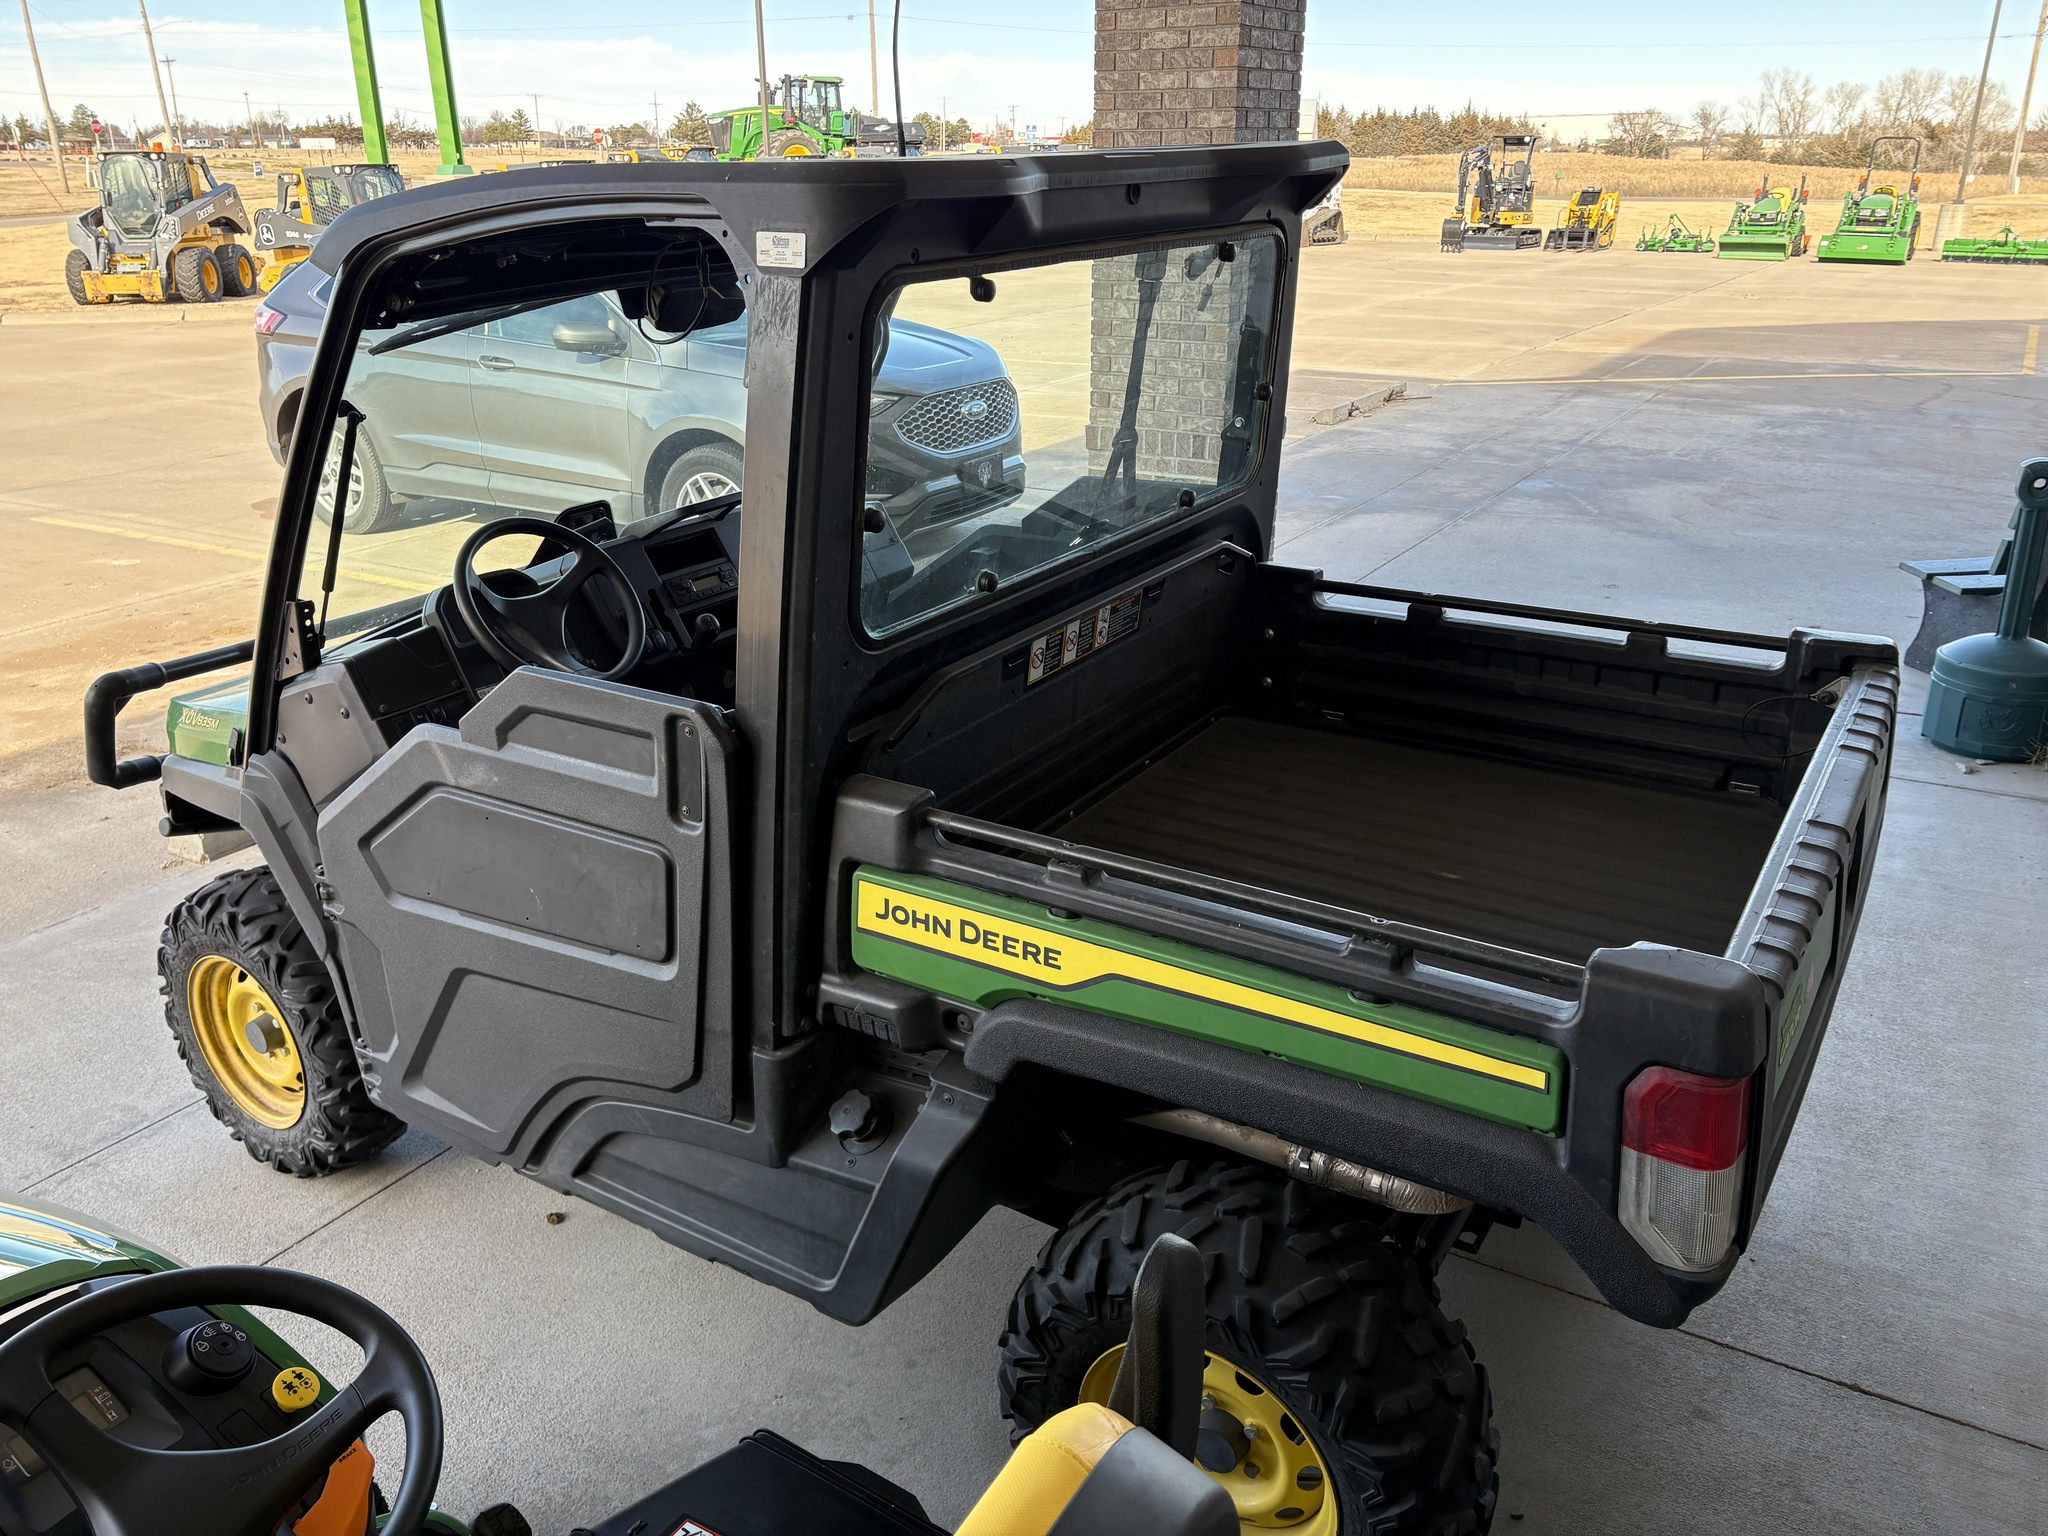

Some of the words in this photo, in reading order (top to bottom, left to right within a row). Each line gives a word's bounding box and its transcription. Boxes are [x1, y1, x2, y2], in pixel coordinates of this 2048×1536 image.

[196, 203, 216, 221] DEERE
[177, 707, 220, 730] XUV835M
[875, 898, 951, 938] JOHN
[960, 919, 1062, 971] DEERE
[226, 1457, 282, 1491] JOHN
[282, 1408, 344, 1461] DEERE
[338, 1447, 358, 1463] BRAKE
